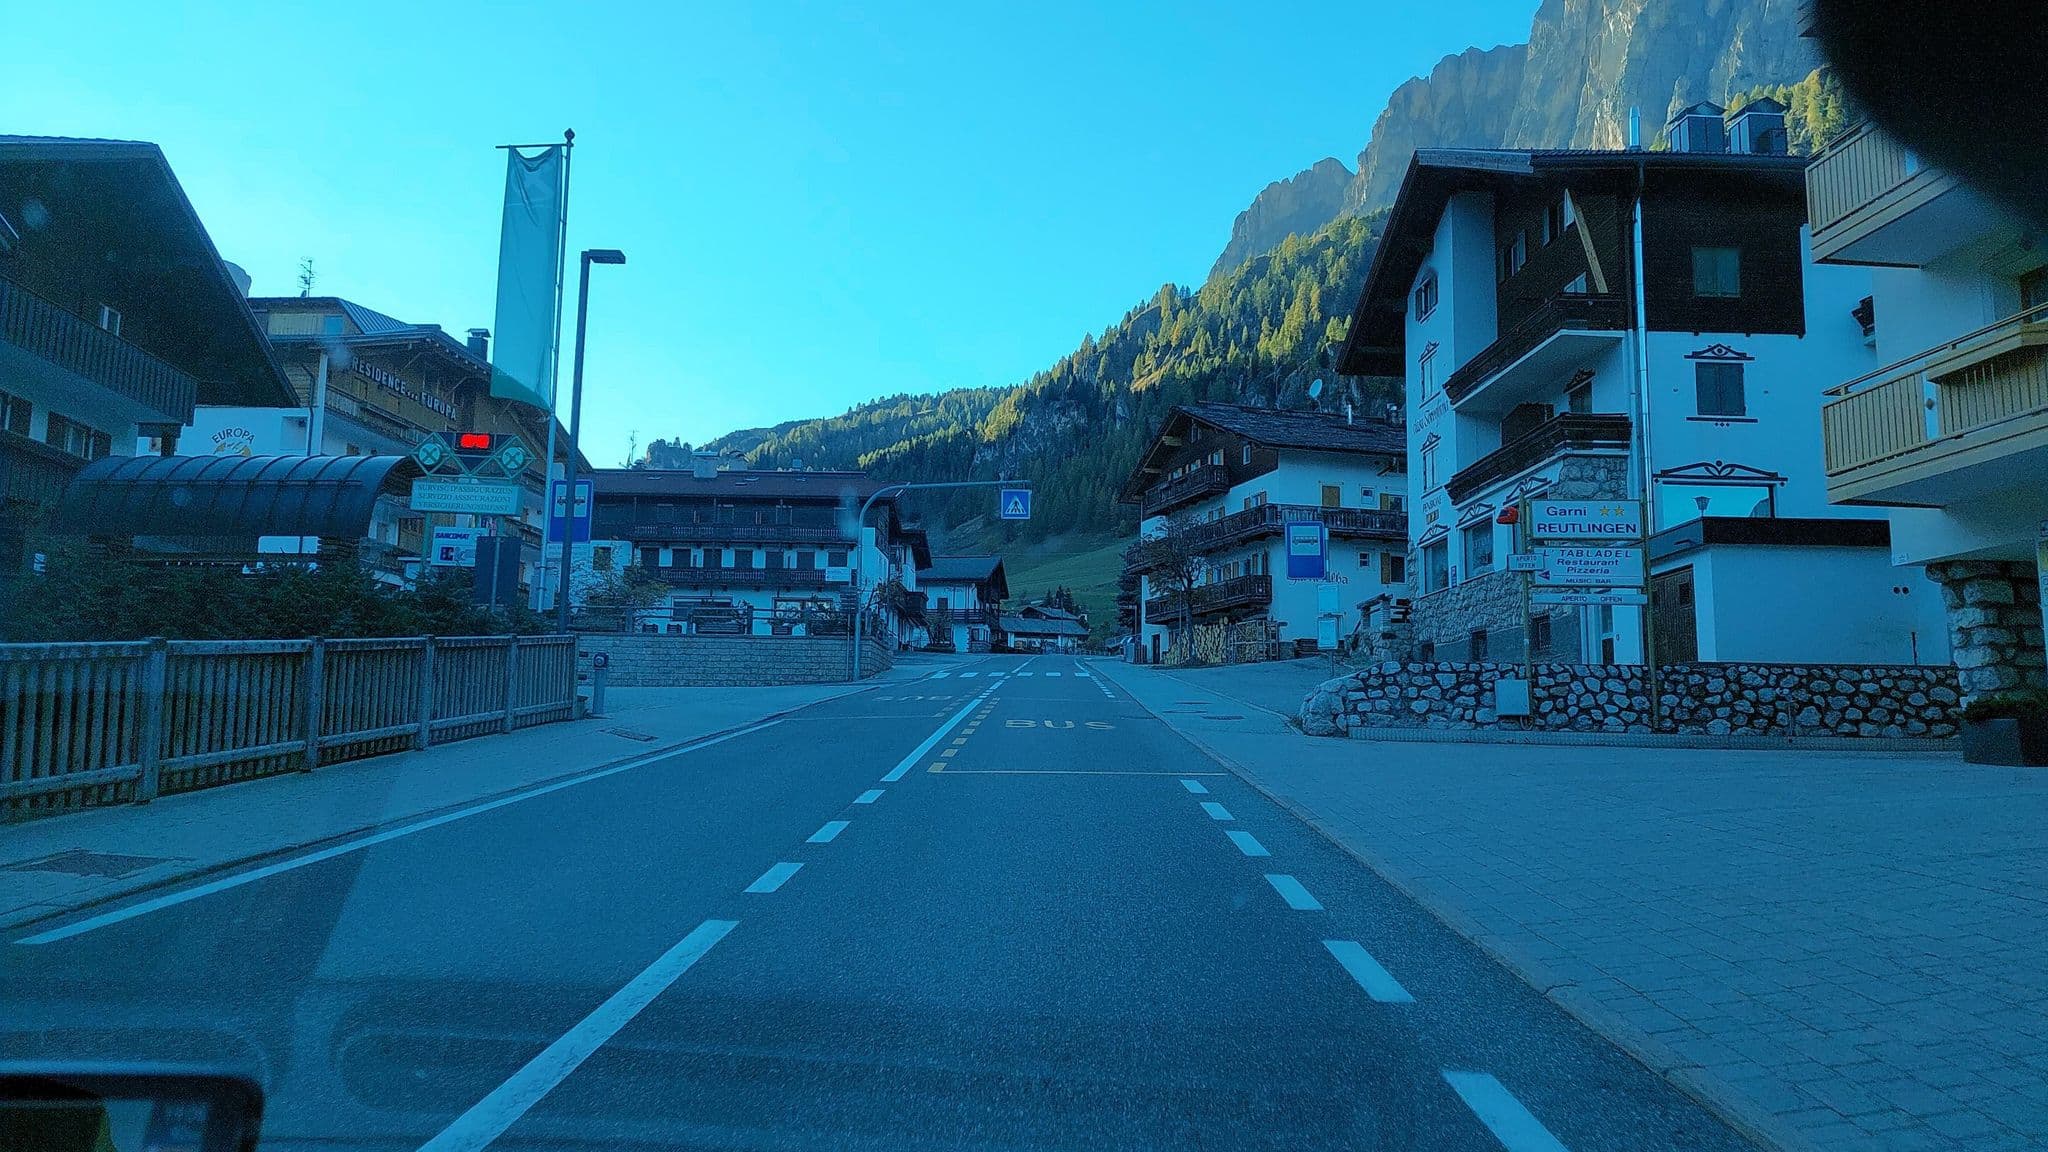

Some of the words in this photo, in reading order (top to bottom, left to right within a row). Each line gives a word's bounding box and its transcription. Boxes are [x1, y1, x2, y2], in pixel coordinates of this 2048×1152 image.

[421, 391, 457, 421] EUROPA
[211, 427, 255, 445] EUROPA
[1546, 506, 1587, 517] Garni
[1537, 523, 1637, 534] REUTLINGEN
[1560, 549, 1633, 558] TABLADEL
[1556, 558, 1620, 566] Restaurant
[1566, 566, 1610, 574] Pizzeria
[1005, 718, 1117, 730] BUS
